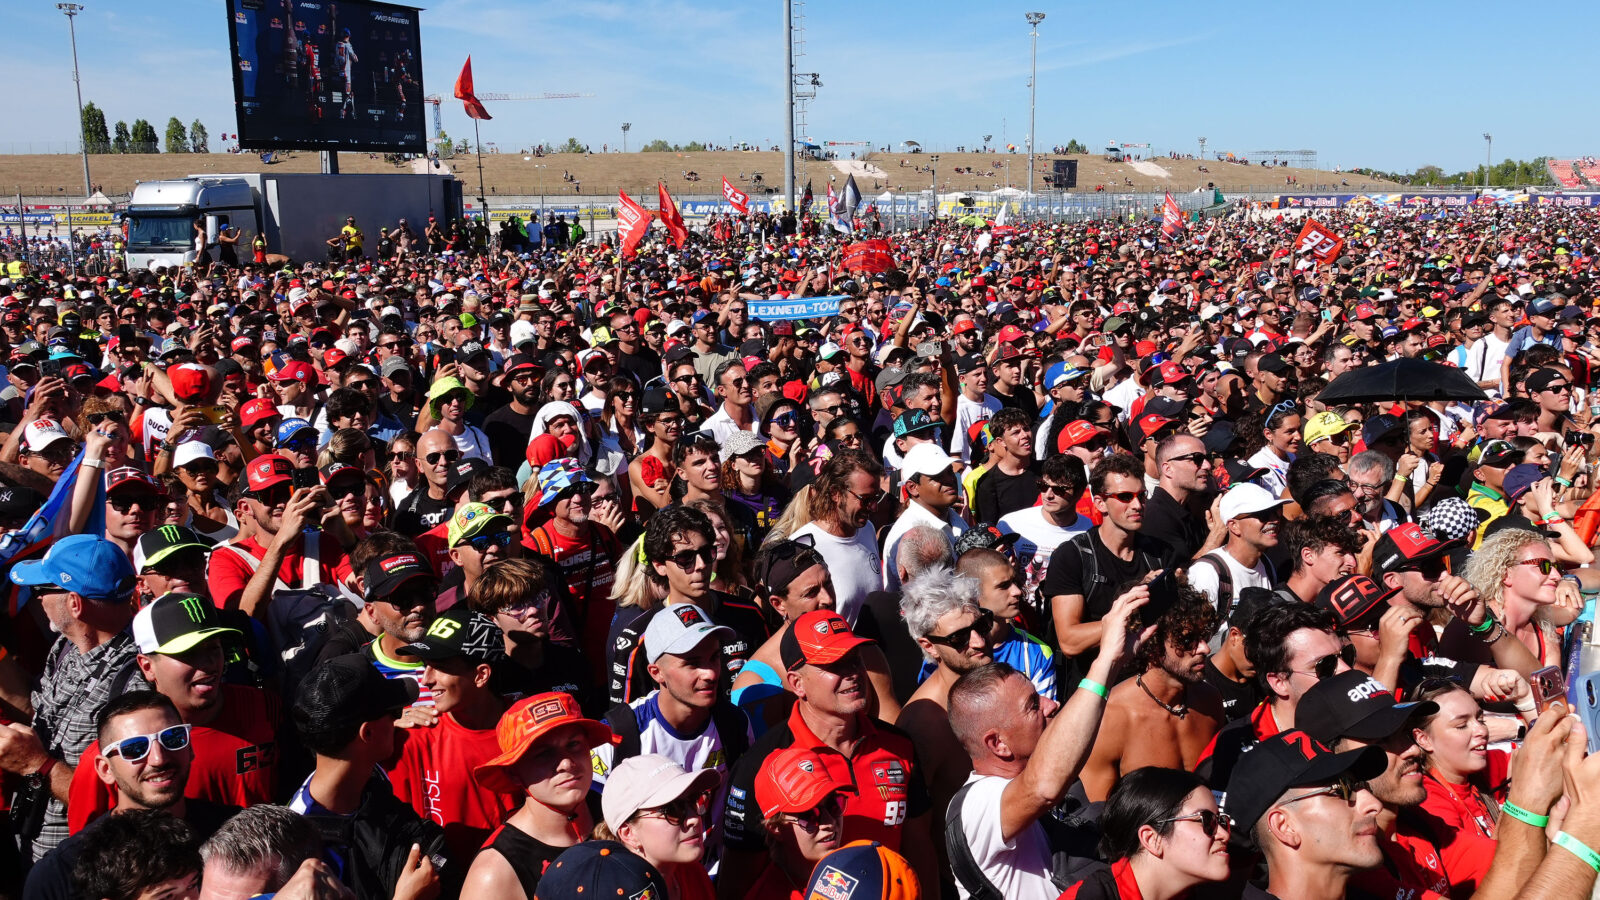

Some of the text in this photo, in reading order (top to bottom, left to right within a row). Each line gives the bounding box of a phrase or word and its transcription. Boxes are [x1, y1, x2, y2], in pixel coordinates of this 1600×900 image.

[723, 180, 746, 206] 93
[695, 204, 765, 213] MICHEIN
[877, 203, 917, 213] MICHEL
[1301, 229, 1337, 254] 93
[66, 364, 87, 377] 72
[148, 418, 170, 434] DUCA
[420, 507, 448, 527] apri
[680, 611, 700, 623] 72
[884, 800, 907, 826] 93
